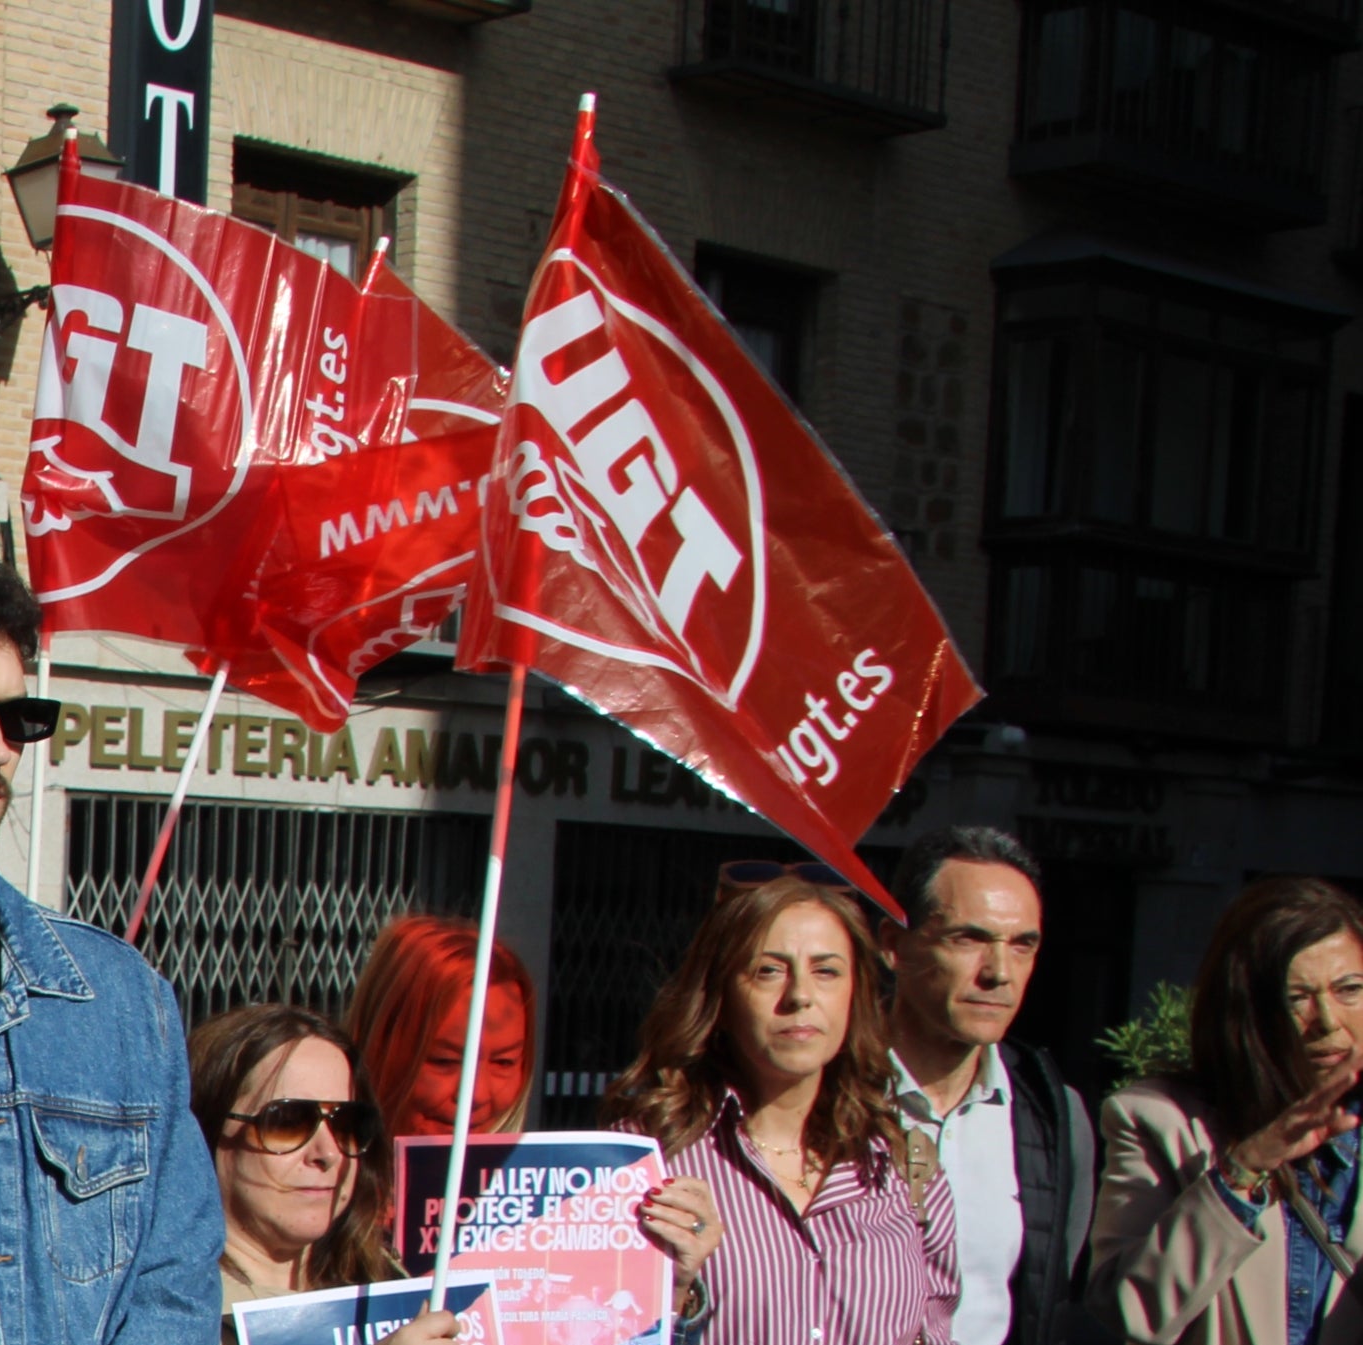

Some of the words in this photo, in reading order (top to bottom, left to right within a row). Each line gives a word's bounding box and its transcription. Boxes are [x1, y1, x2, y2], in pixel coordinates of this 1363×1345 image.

[306, 327, 358, 456] gt.es
[519, 290, 743, 638] UGT
[366, 727, 586, 797] AMADOR
[480, 1168, 505, 1196] LA
[509, 1168, 548, 1195] LEY
[551, 1167, 591, 1195] NO
[595, 1167, 650, 1195] NOS
[426, 1196, 537, 1225] POTEGE,
[543, 1196, 563, 1223] EL
[458, 1225, 526, 1252] EXIGE
[530, 1224, 647, 1250] CAMBIOS
[455, 1310, 485, 1341] OS
